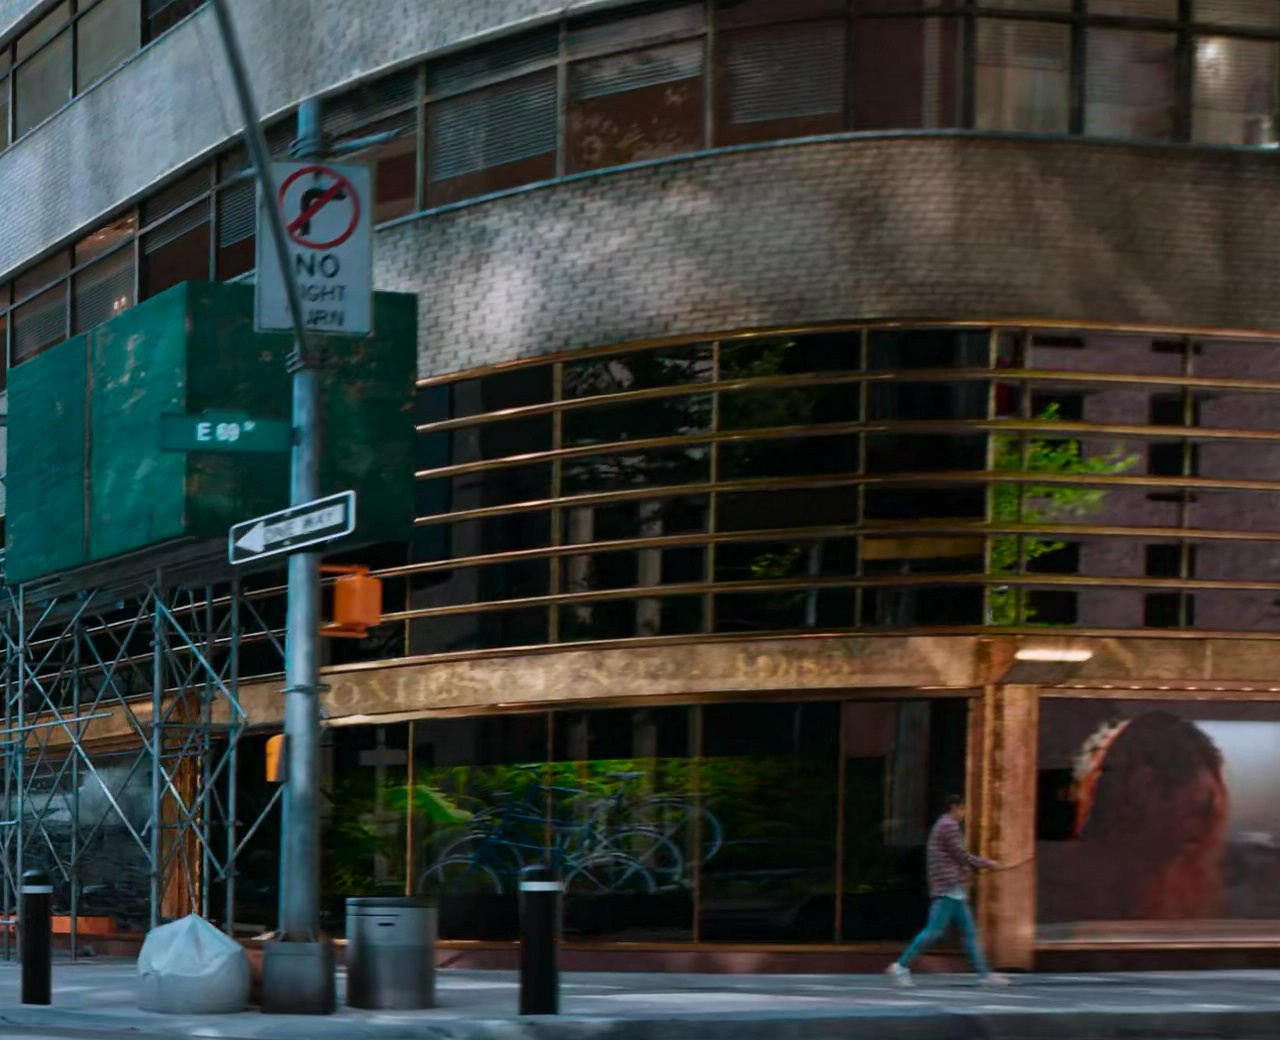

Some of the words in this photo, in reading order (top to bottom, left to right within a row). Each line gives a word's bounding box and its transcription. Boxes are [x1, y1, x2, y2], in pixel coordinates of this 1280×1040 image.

[295, 253, 340, 278] NO
[299, 284, 347, 302] IGHT
[197, 421, 212, 441] E
